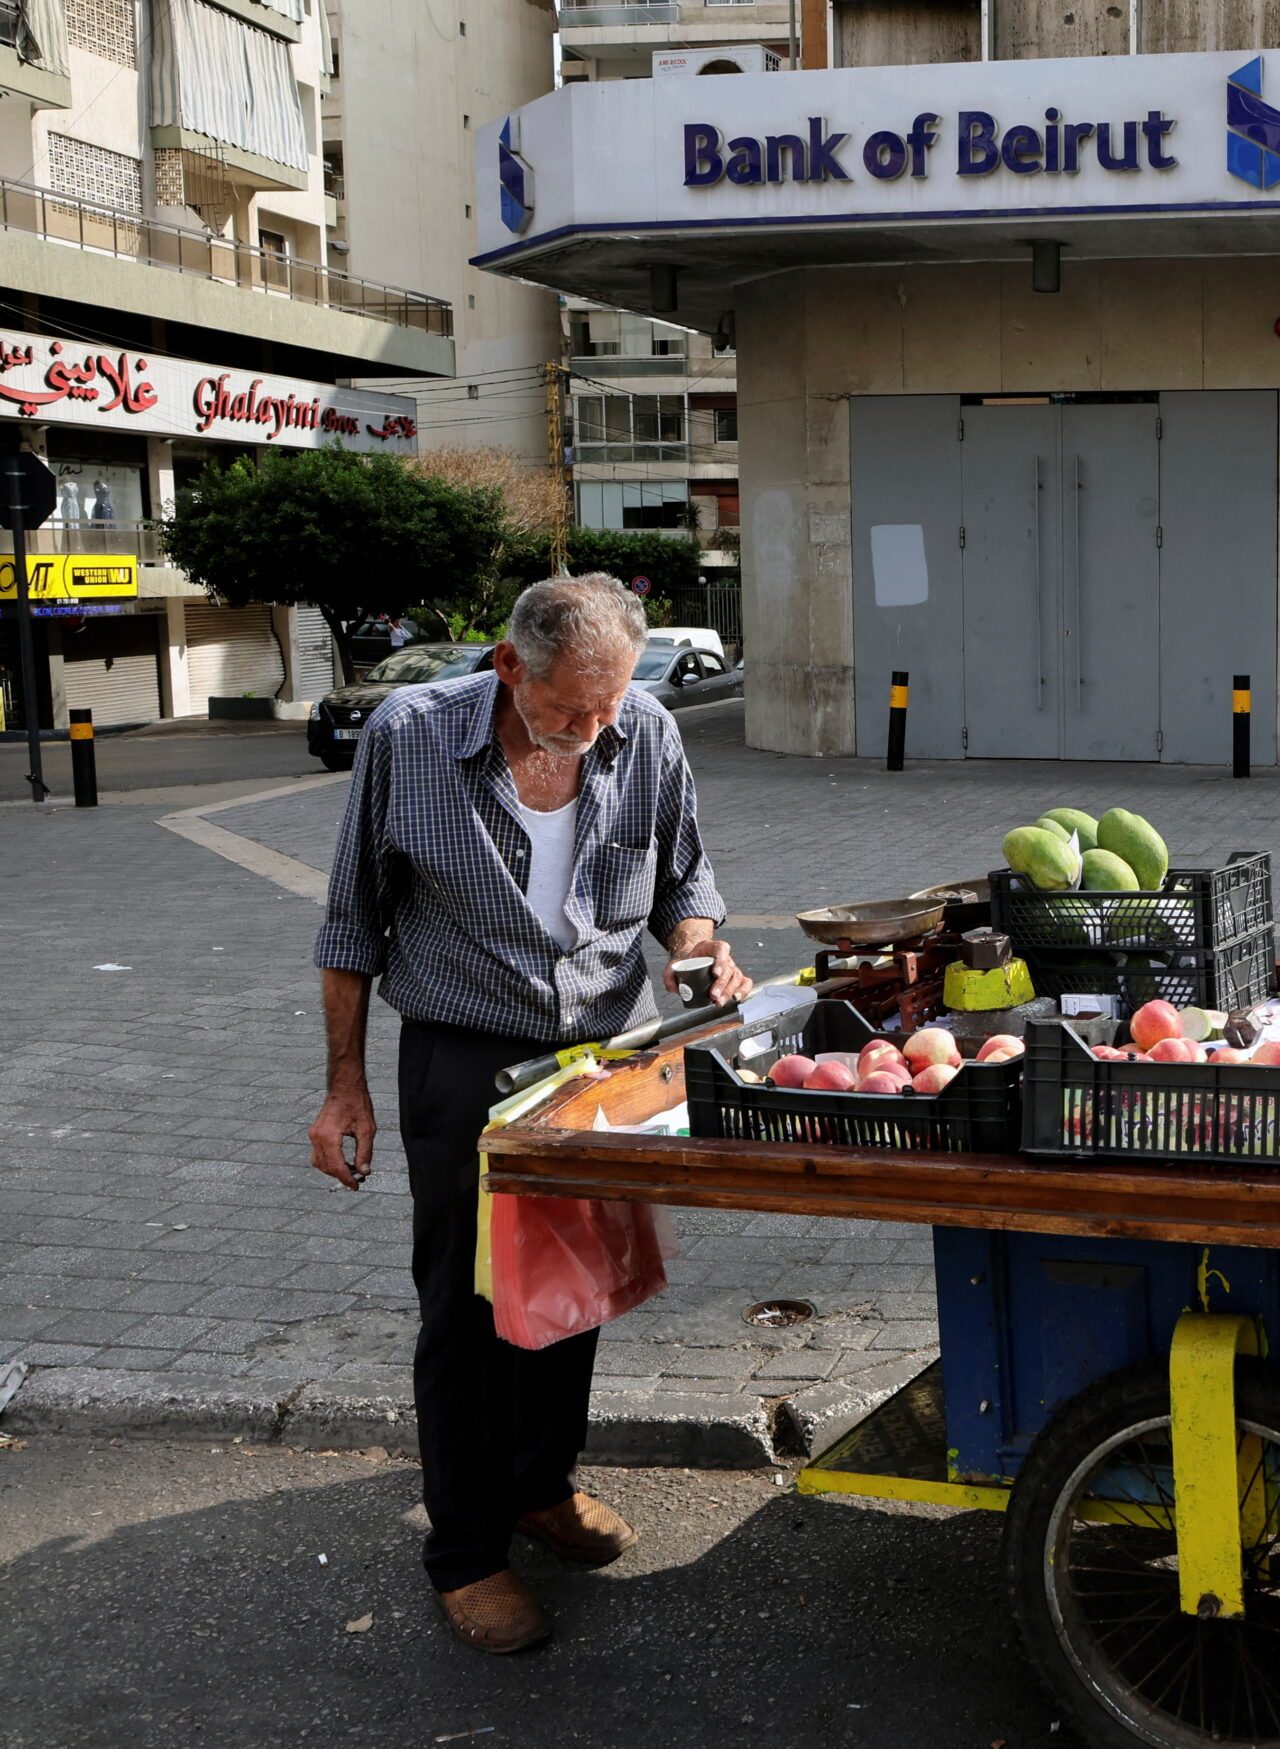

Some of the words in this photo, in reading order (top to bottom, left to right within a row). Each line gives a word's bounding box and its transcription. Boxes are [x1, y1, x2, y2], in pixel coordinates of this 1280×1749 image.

[683, 116, 852, 187] Bank
[863, 112, 943, 182] of
[957, 107, 1178, 177] Beirut
[193, 373, 321, 440] Ghalayini
[73, 568, 107, 577] WESTERN
[84, 575, 108, 584] UNION
